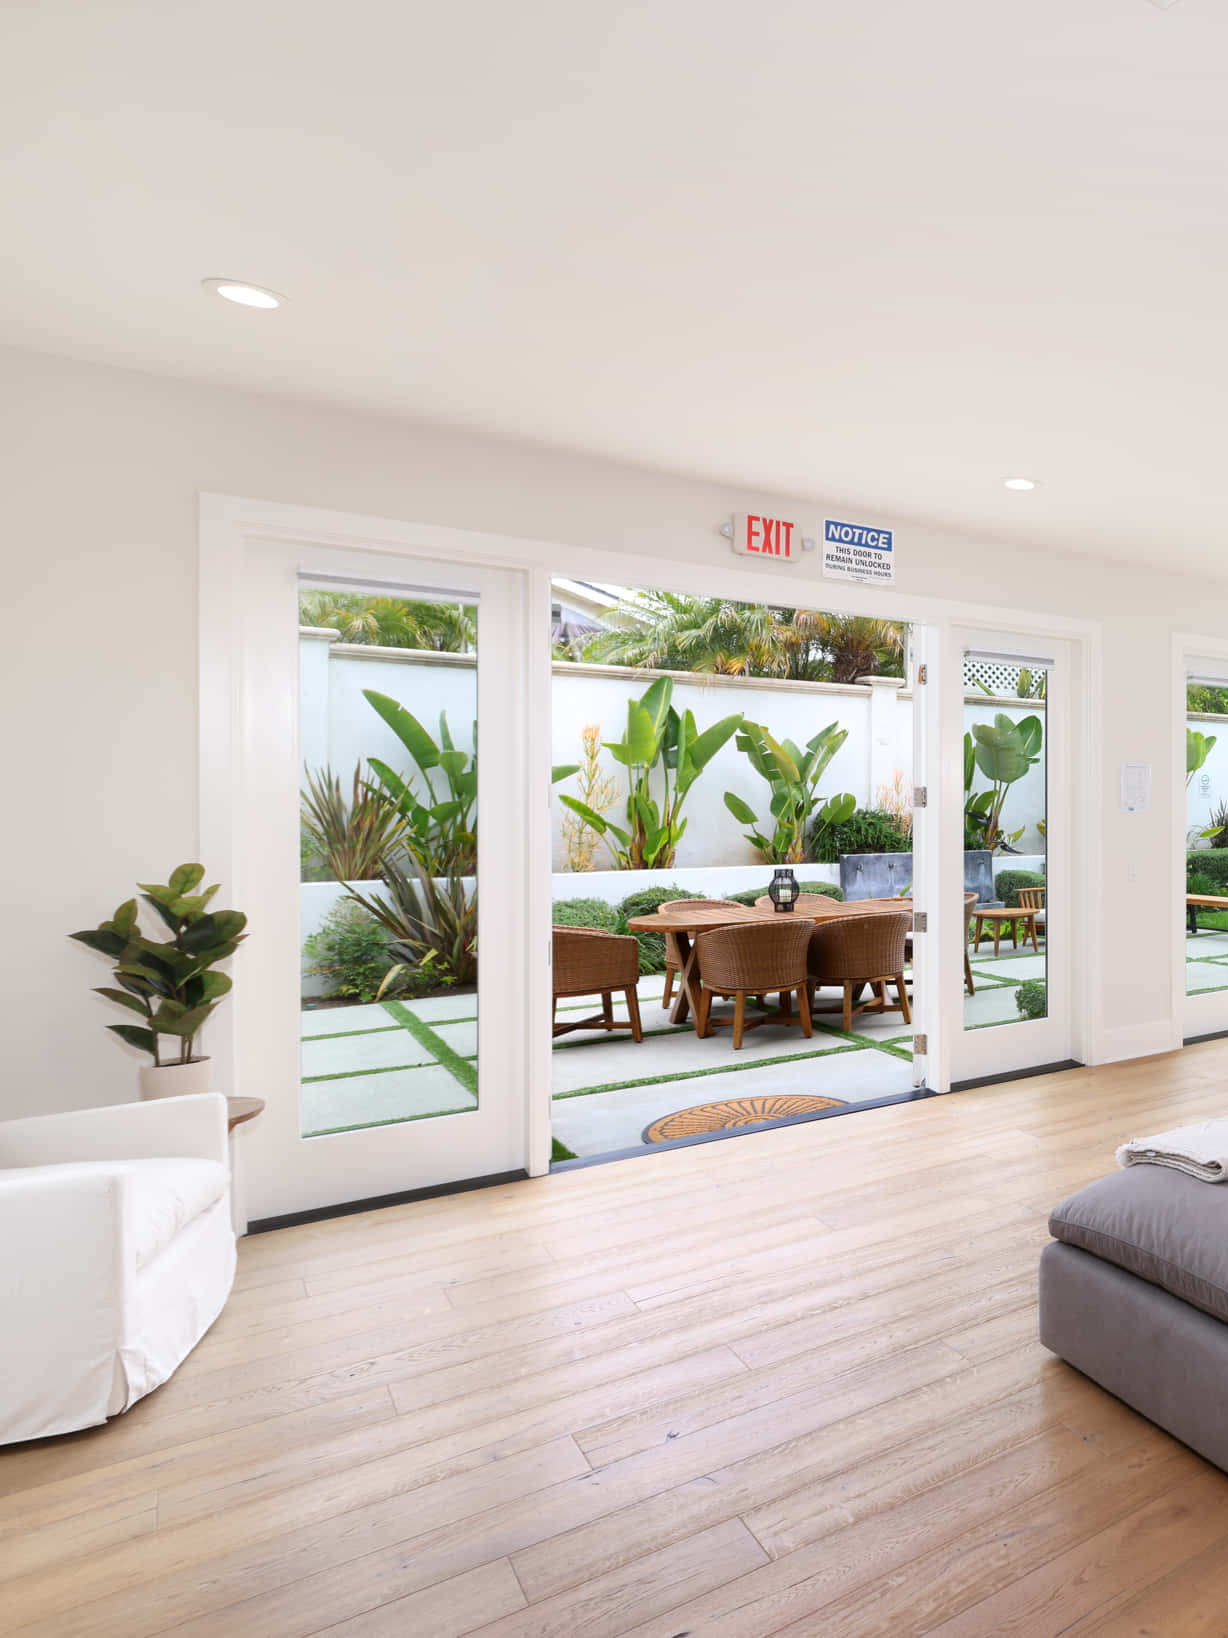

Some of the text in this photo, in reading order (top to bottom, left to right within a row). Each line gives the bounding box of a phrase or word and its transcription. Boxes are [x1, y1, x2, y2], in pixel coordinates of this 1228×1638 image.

[747, 515, 794, 557] EXIT
[828, 524, 889, 548] NOTICE
[826, 553, 891, 570] REMAIN UNLOCKED
[835, 546, 883, 560] THIS DOOR TO
[847, 566, 872, 575] BUSINESS
